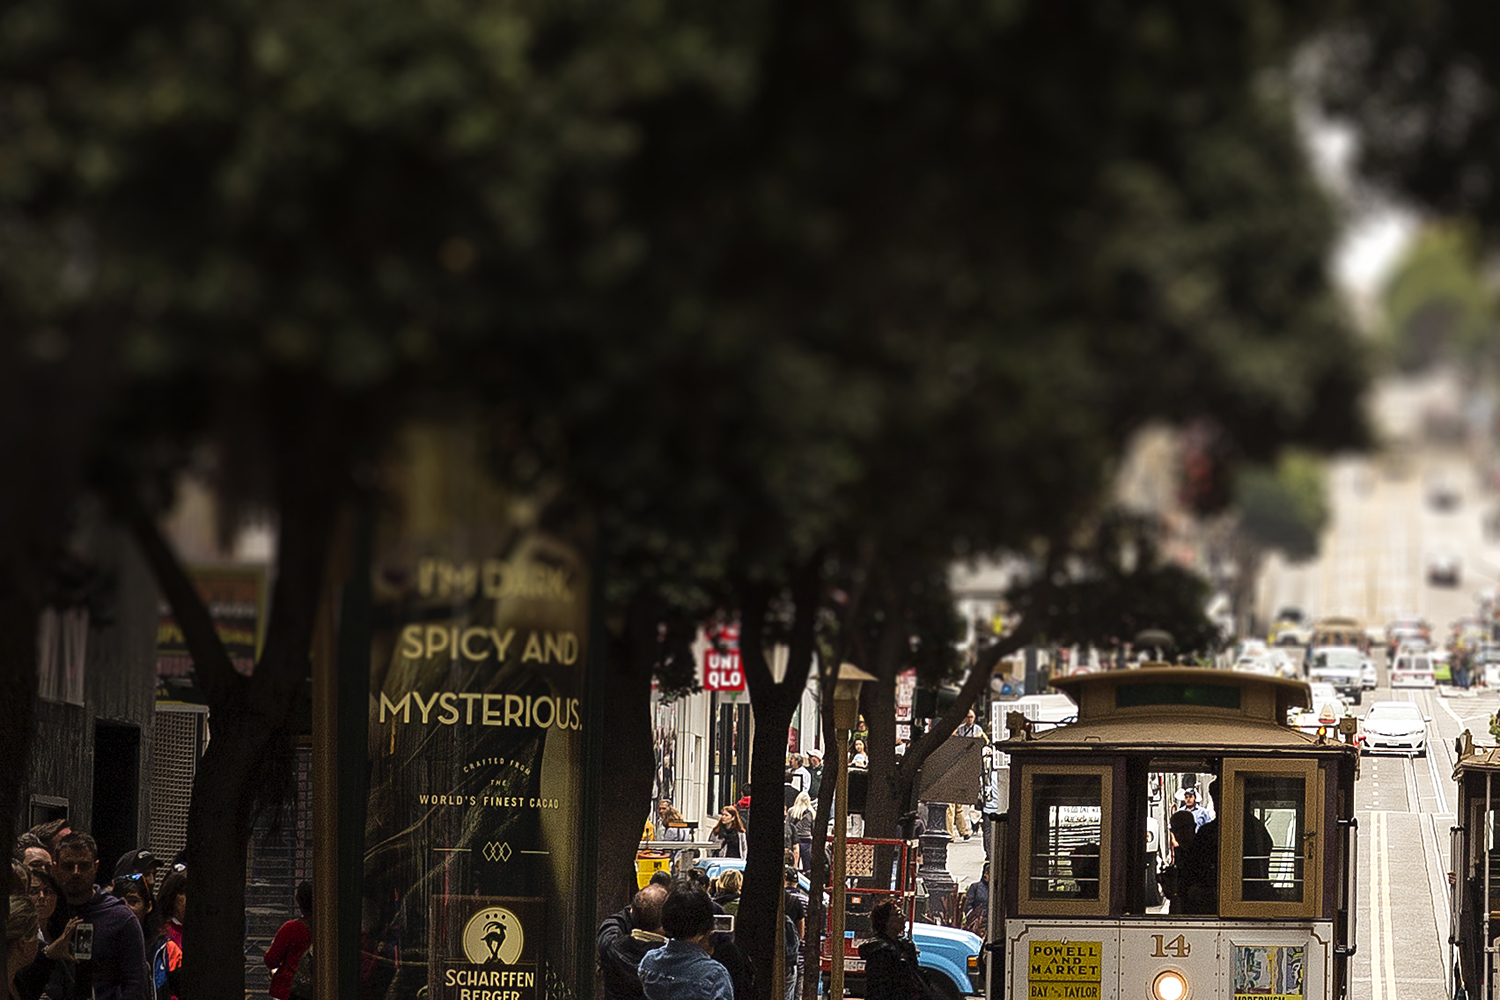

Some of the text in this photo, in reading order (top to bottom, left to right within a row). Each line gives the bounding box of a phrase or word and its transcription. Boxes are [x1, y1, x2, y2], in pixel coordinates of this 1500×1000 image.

[401, 624, 580, 666] SPICY AND
[708, 654, 740, 670] UNI
[708, 671, 742, 689] QLO
[379, 691, 583, 731] MYSTERIOUS.
[463, 757, 531, 776] CRAFTED FROM
[490, 779, 507, 787] THE
[419, 794, 559, 809] WORLD'S FINEST CACAO
[1033, 946, 1098, 957] POWELL
[1150, 934, 1191, 958] 14
[1049, 957, 1082, 965] AND
[1031, 964, 1098, 975] MARKET
[445, 969, 534, 988] SCHARFFEN
[1031, 986, 1048, 998] BAY
[1064, 986, 1098, 998] TAYLOR
